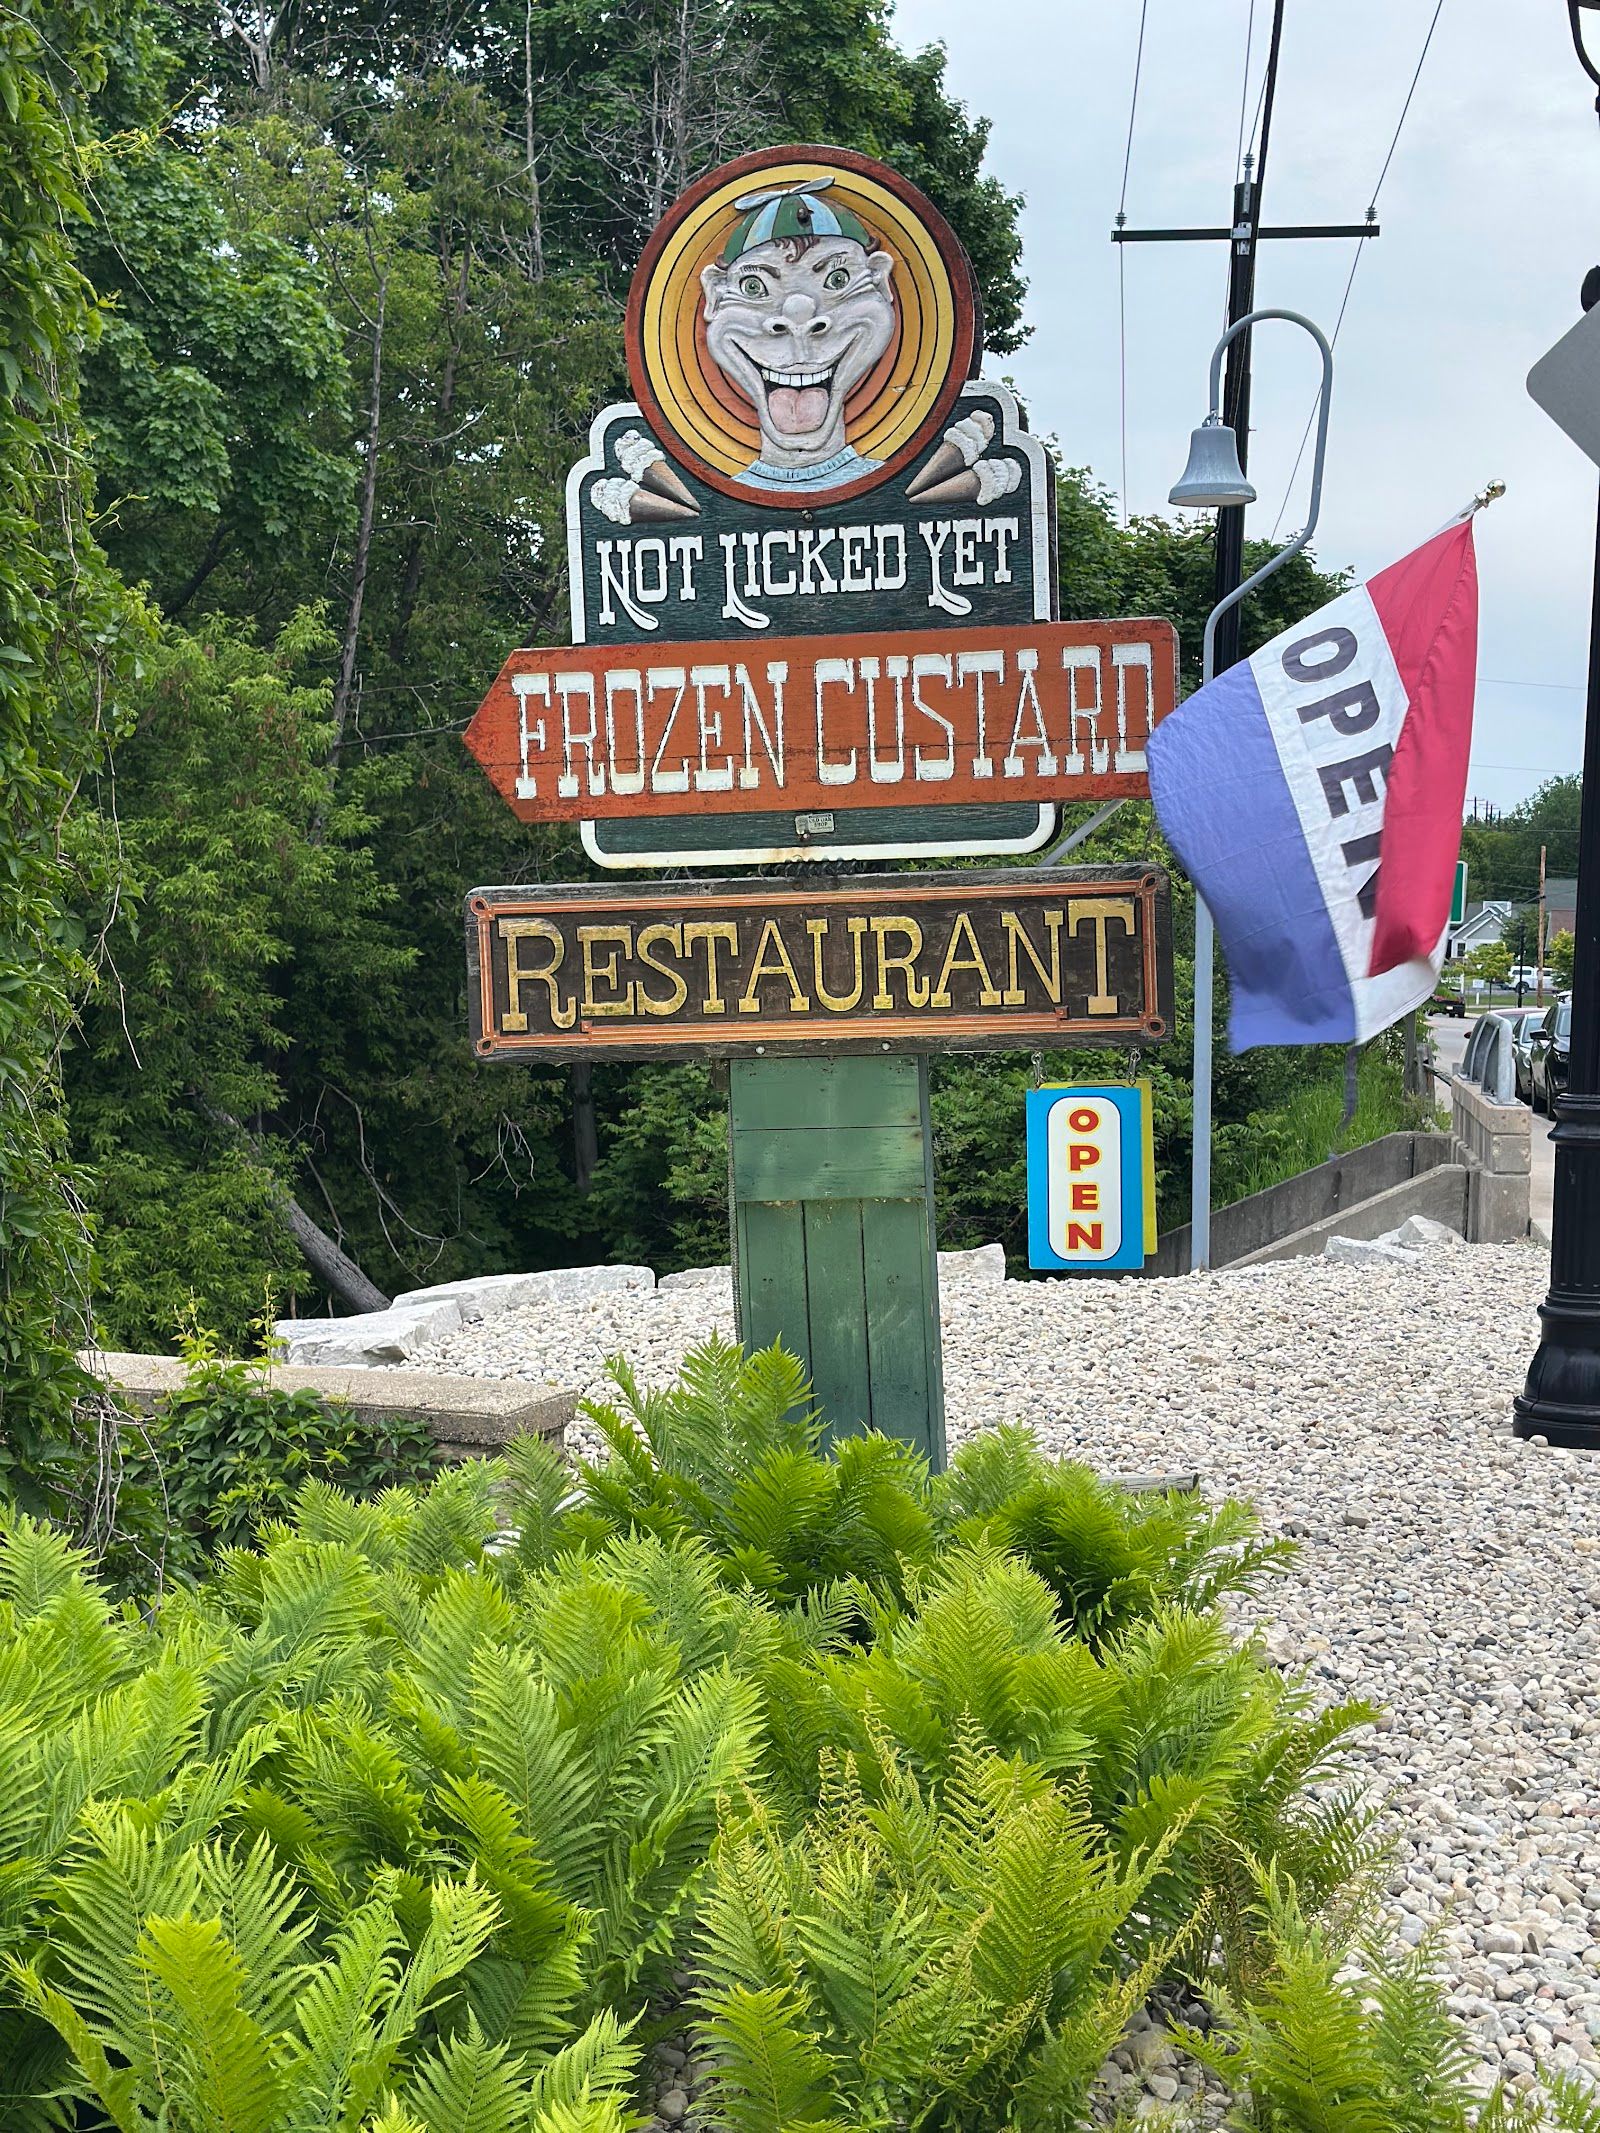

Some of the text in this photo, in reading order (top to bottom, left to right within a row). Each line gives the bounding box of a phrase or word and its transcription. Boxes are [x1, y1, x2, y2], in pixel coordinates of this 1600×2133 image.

[596, 518, 1020, 631] NOT LICKED YET
[511, 641, 1153, 800] FROZEN CUSTARD
[498, 897, 1136, 1031] RESTAURANT
[1066, 1106, 1105, 1251] OPEN
